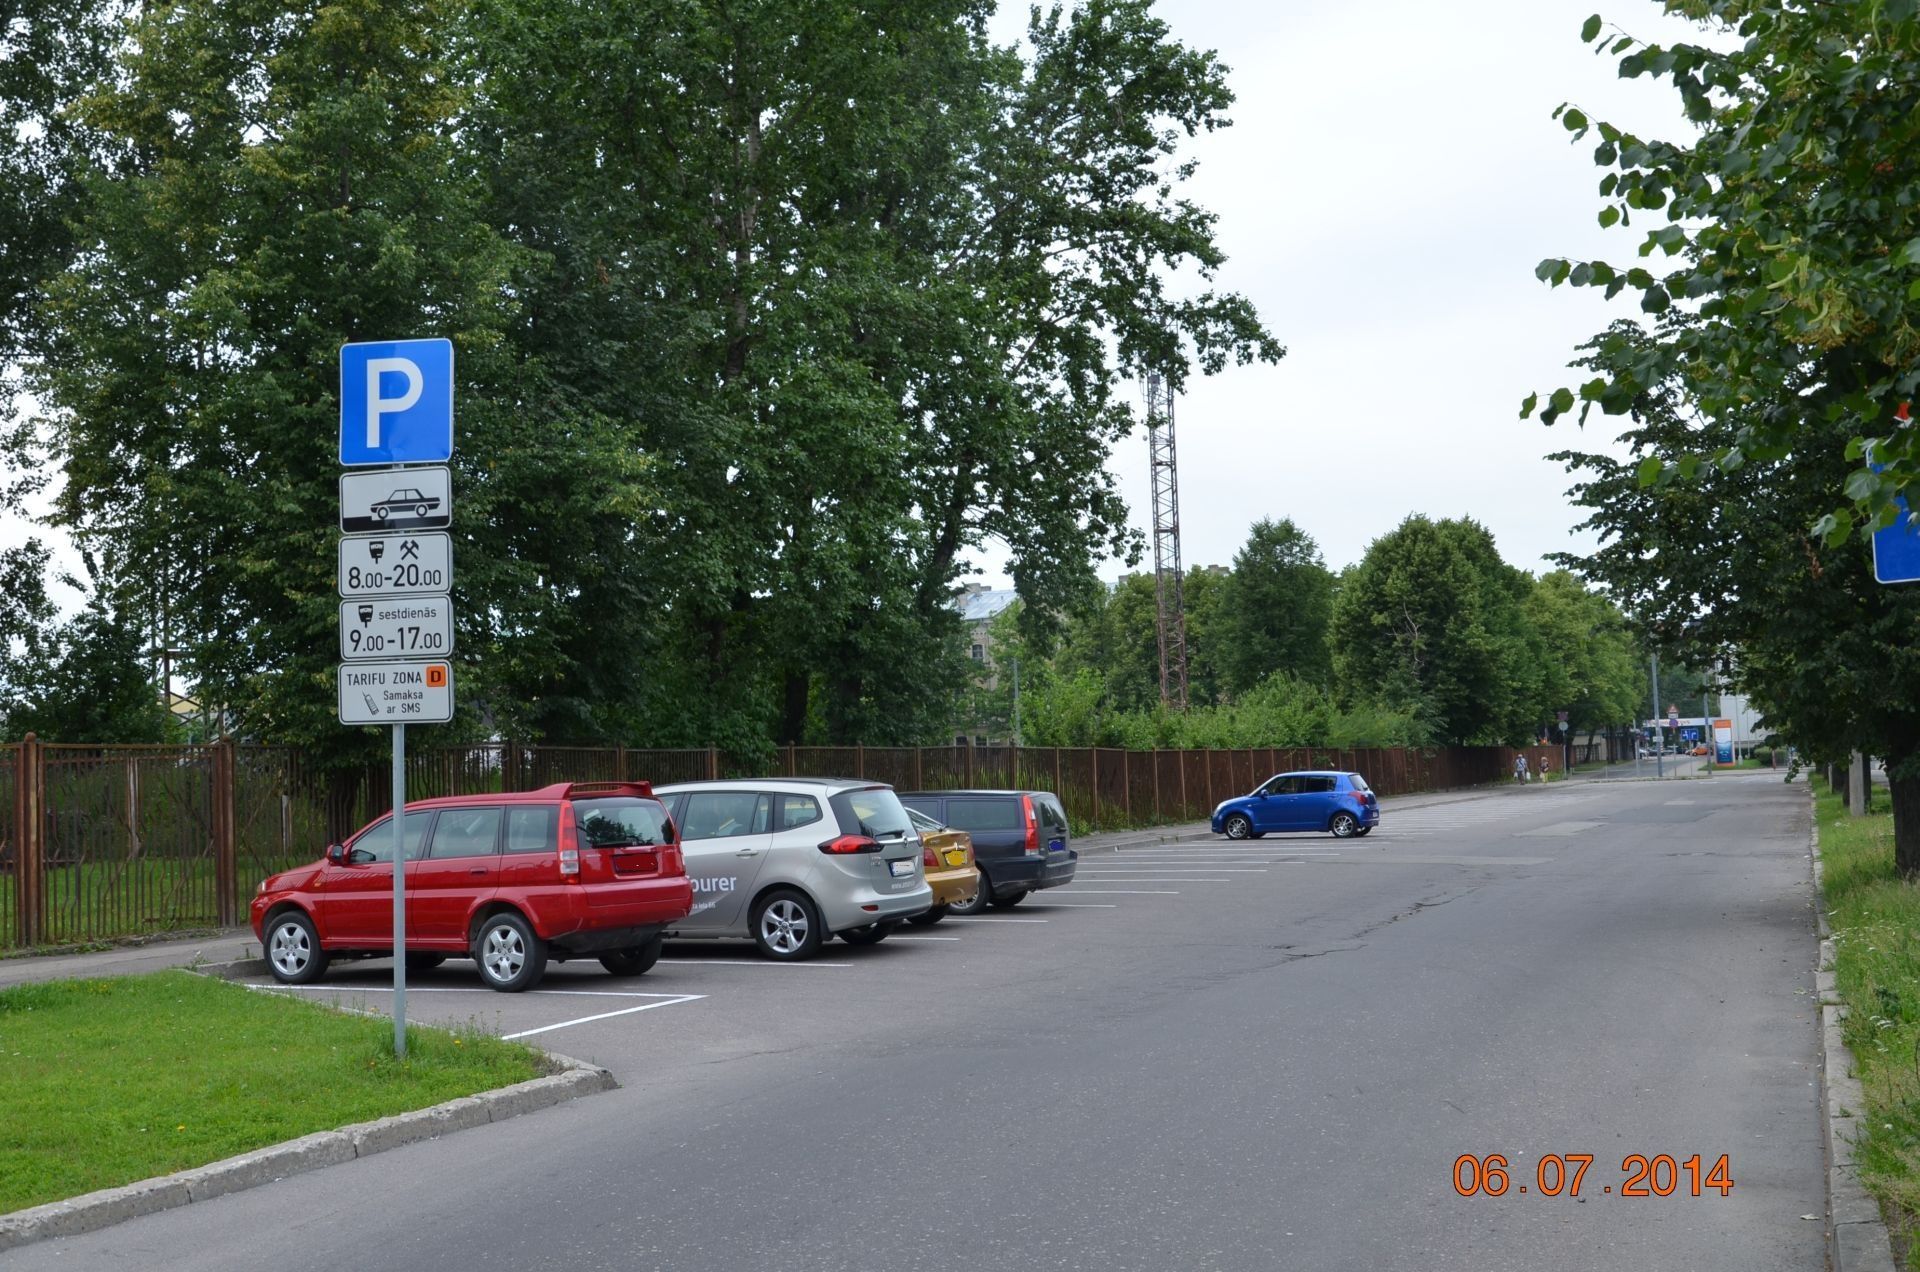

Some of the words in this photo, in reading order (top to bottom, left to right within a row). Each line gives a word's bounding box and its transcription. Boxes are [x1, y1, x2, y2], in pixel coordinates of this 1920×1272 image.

[366, 357, 424, 449] P
[348, 564, 442, 589] 8.00-20.00
[378, 607, 437, 620] sestdienās
[350, 626, 442, 652] 9.00-17.00
[347, 672, 386, 686] TARIFU
[393, 672, 422, 684] ZONA
[430, 671, 442, 682] D
[383, 690, 423, 701] Samaksa
[386, 705, 396, 714] ar
[401, 703, 421, 713] SMS
[686, 875, 737, 892] ourer
